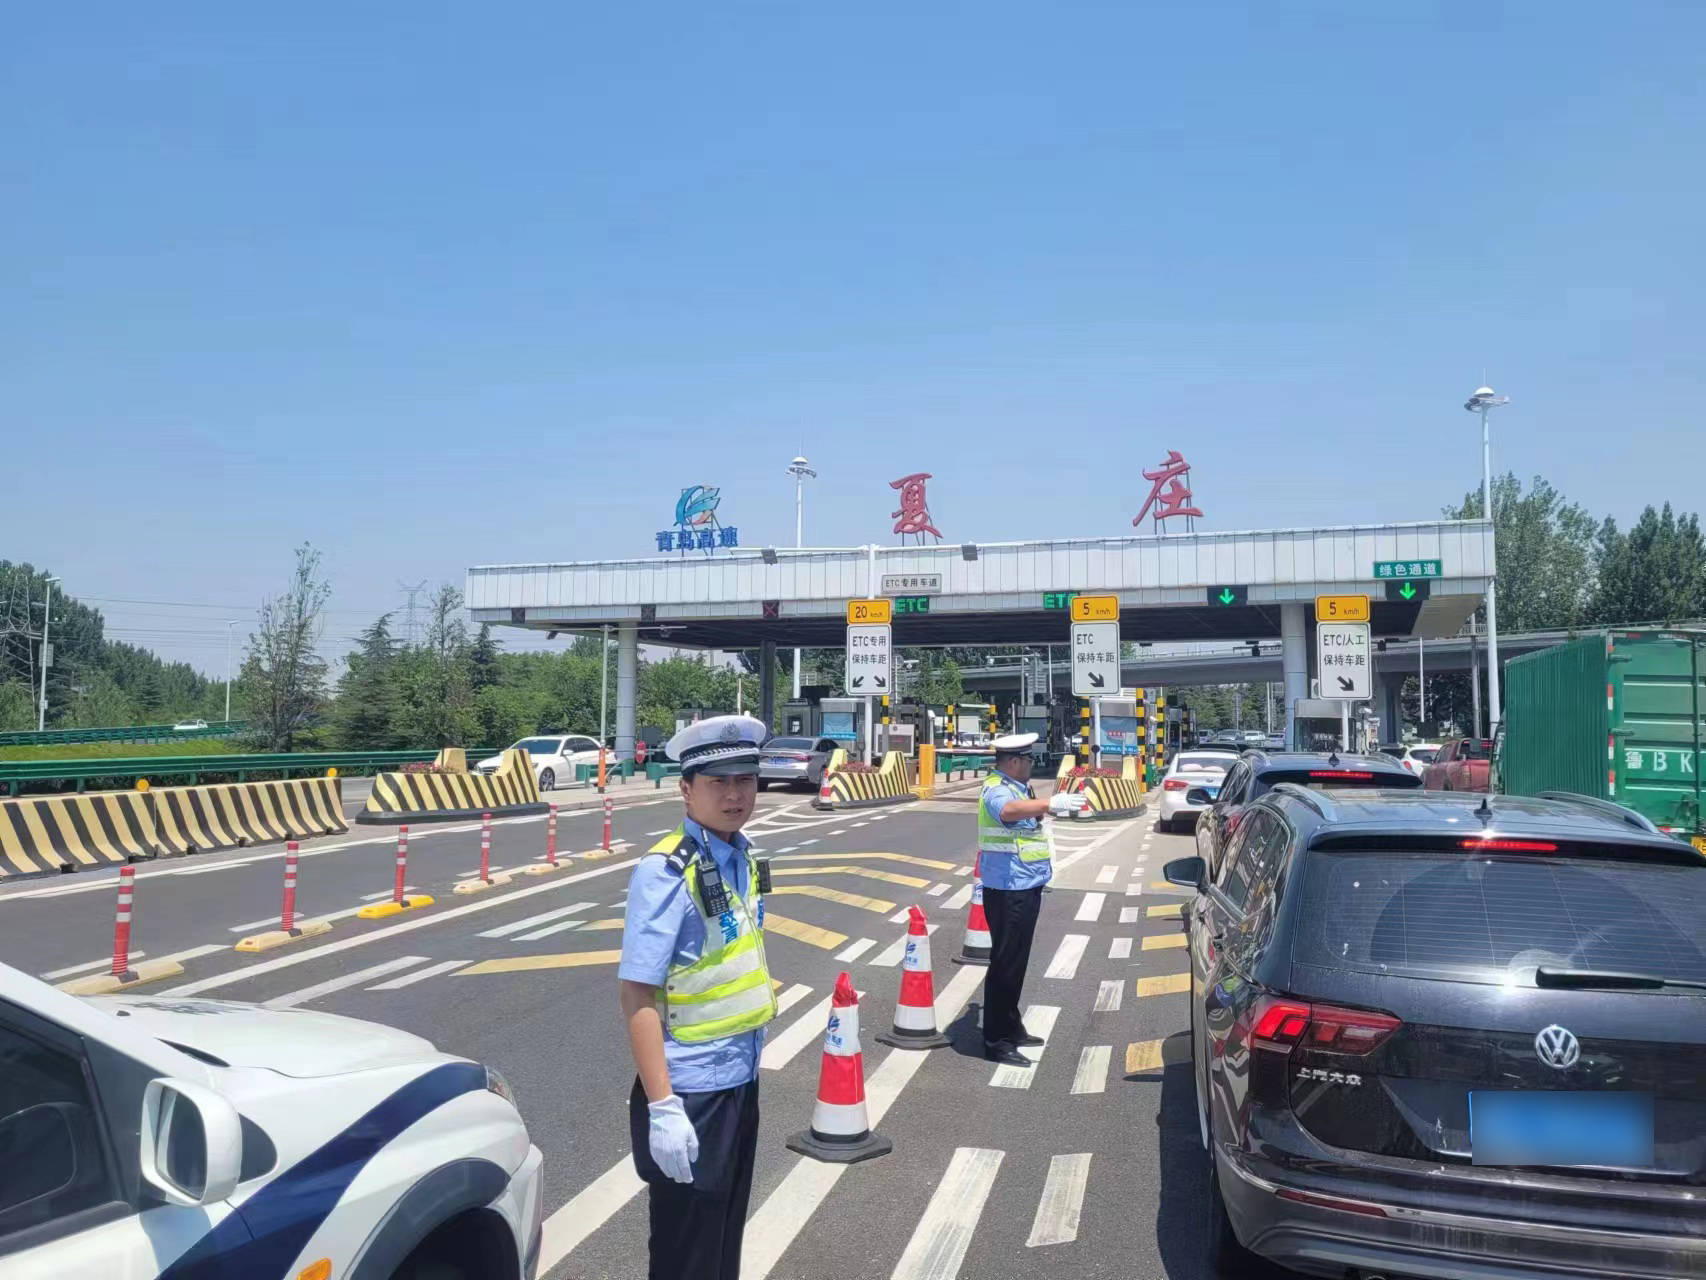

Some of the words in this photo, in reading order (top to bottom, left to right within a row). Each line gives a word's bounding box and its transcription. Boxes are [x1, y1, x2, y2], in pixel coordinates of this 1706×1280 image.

[655, 525, 738, 552] 青岛高速
[1379, 561, 1437, 577] 绿色通道
[895, 598, 928, 613] ETC
[1083, 603, 1090, 615] 5
[1329, 603, 1337, 615] 5
[1343, 607, 1359, 616] km/h
[855, 606, 868, 618] 20
[852, 635, 886, 647] ETC专用
[1077, 633, 1094, 645] ETC
[1323, 634, 1365, 646] ETC/人工
[852, 652, 886, 664] 保持车距
[1076, 652, 1115, 664] 保持车距
[1324, 654, 1366, 666] 保持车距
